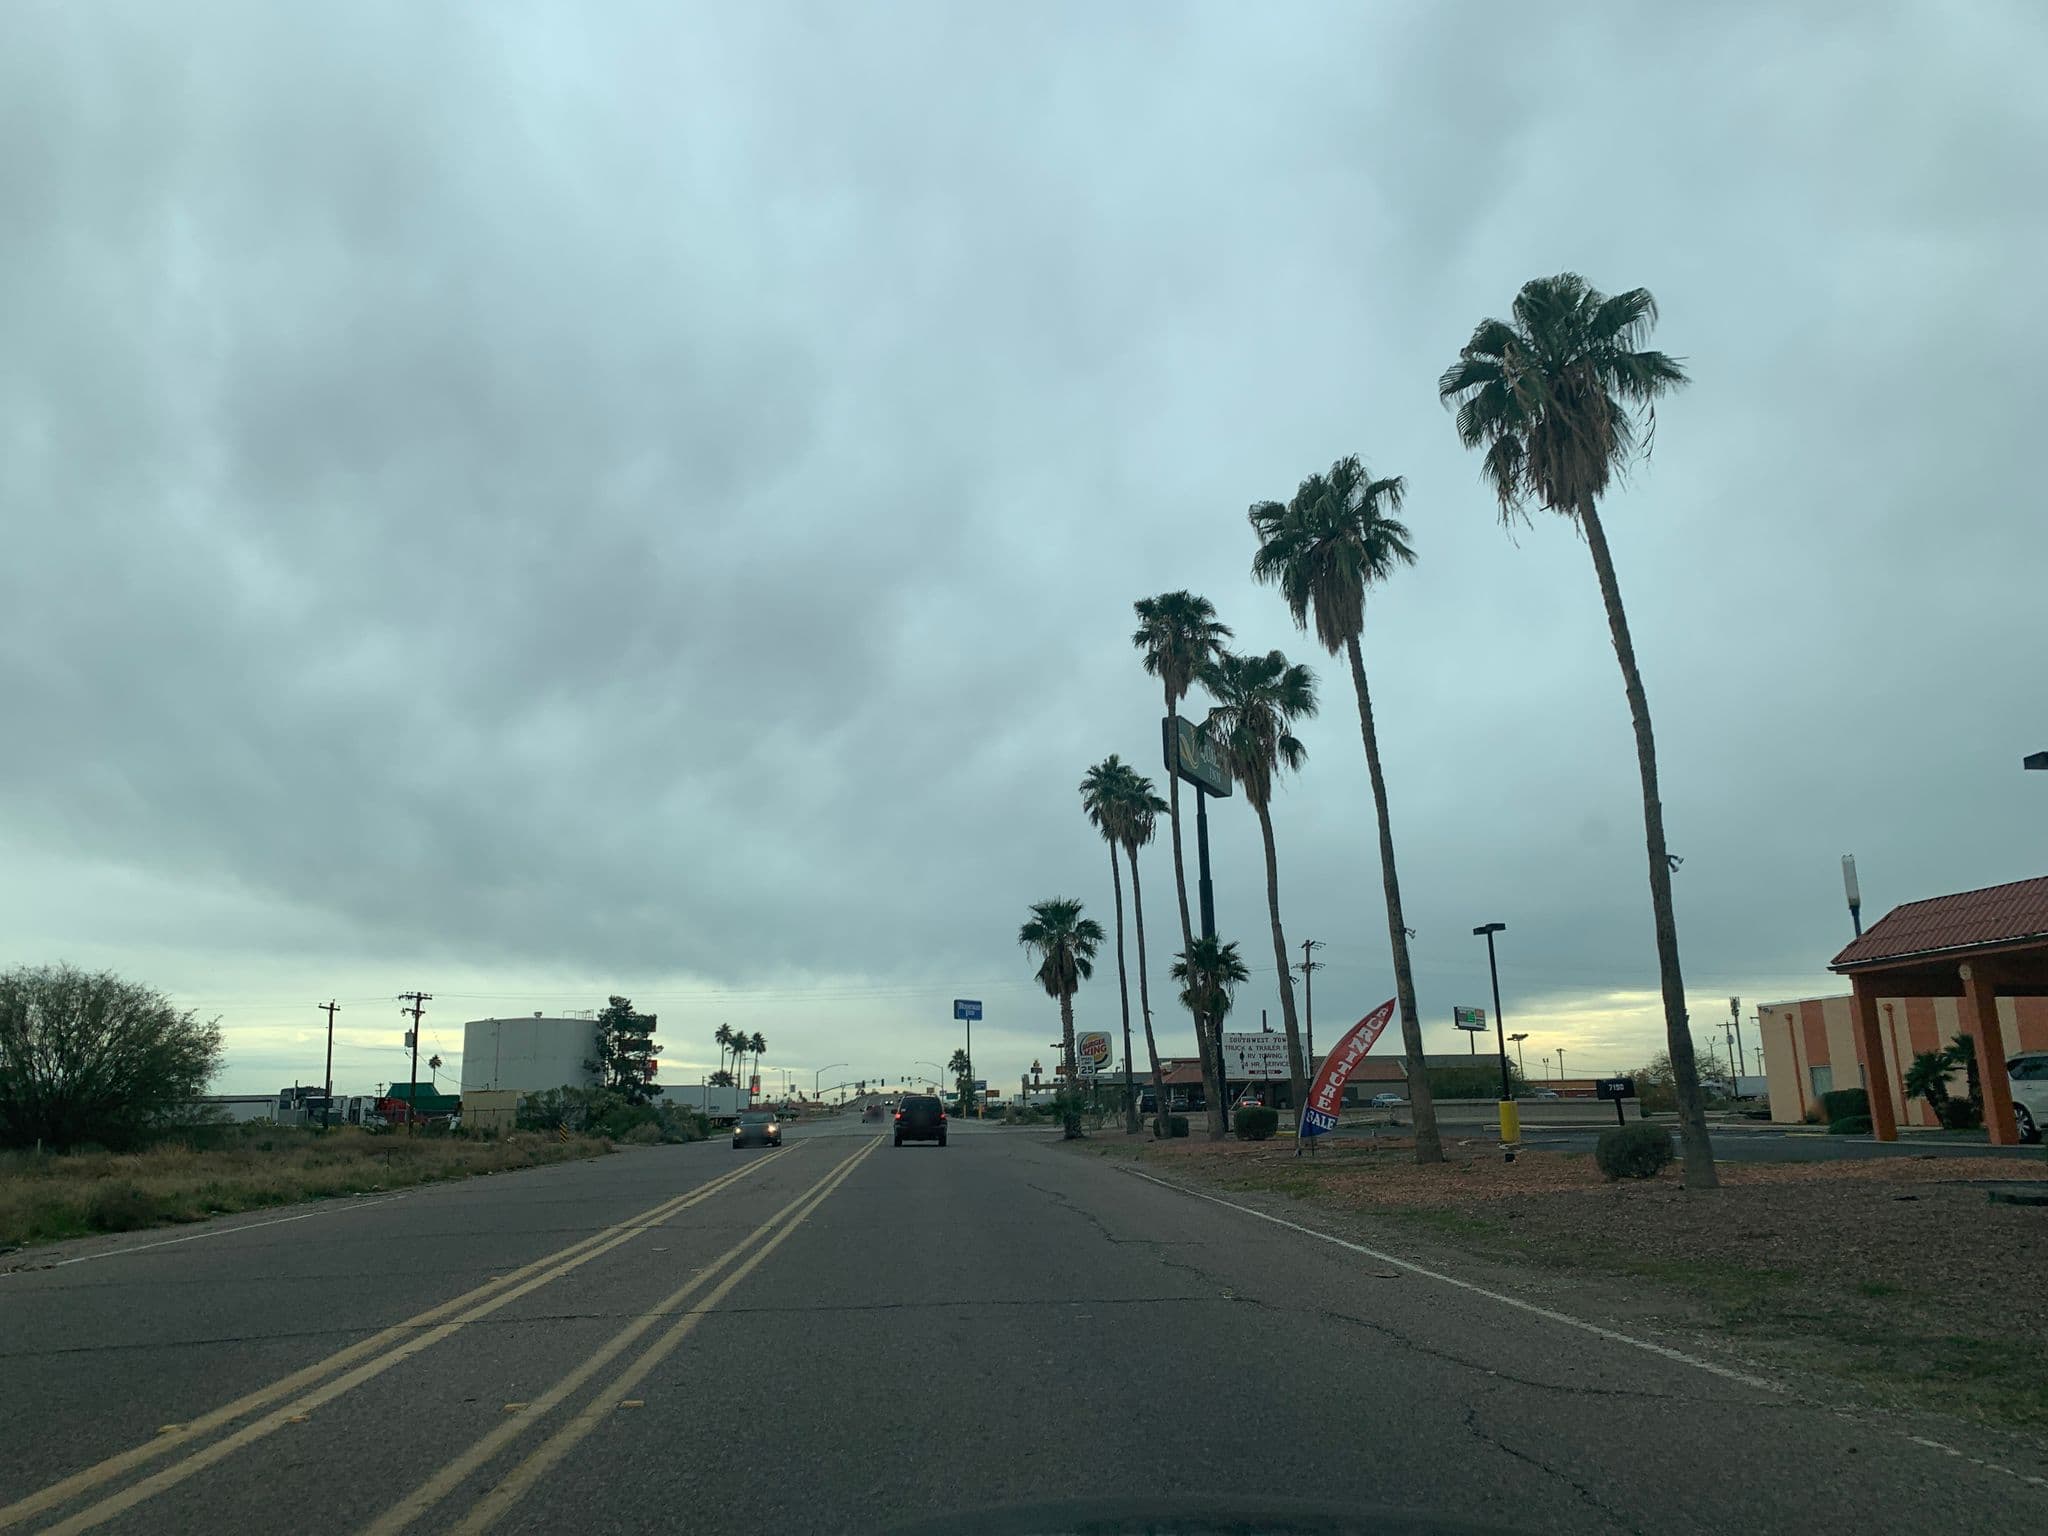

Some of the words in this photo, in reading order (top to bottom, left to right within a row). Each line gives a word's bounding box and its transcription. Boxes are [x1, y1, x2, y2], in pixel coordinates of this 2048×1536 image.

[1083, 1044, 1107, 1056] KING
[1081, 1066, 1093, 1074] 25
[1306, 1110, 1336, 1130] SALE
